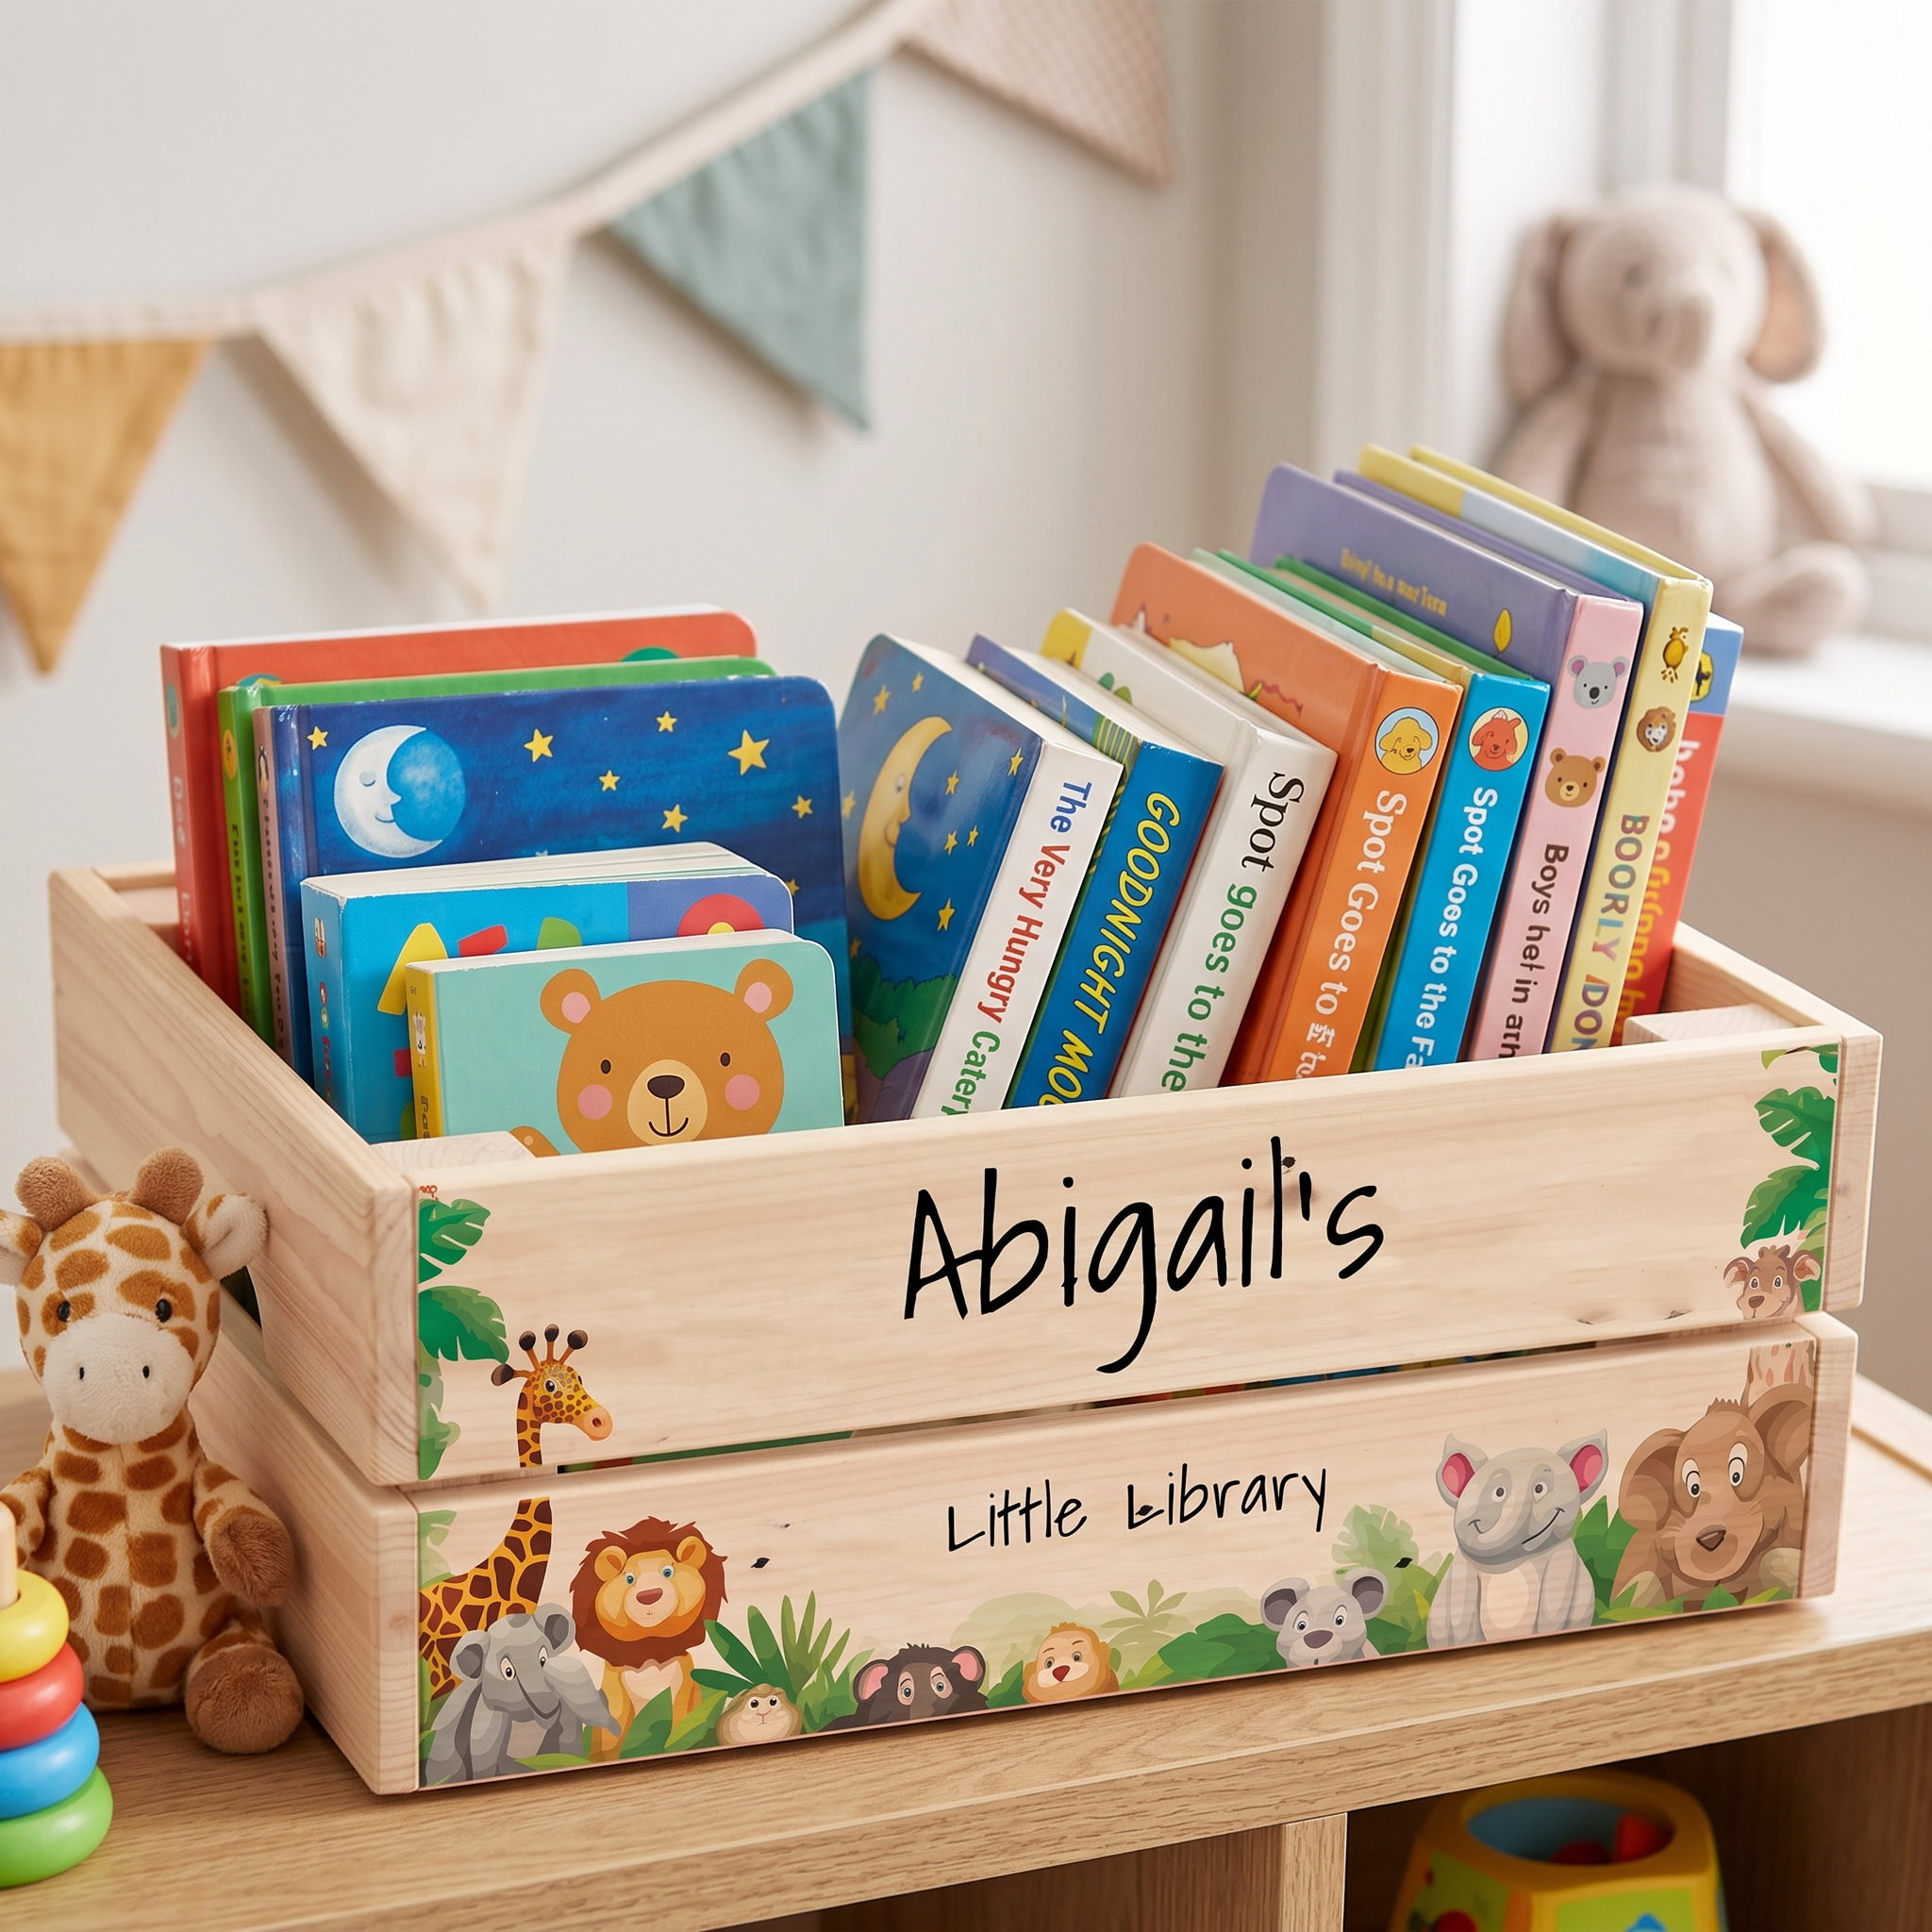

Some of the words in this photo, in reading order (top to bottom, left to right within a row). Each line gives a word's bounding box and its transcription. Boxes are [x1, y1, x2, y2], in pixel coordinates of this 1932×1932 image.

[1049, 782, 1093, 834] The
[1241, 771, 1306, 873] Spot
[1356, 790, 1407, 874] Spot
[1458, 787, 1499, 856] Spot
[1018, 844, 1072, 909] Very
[1074, 791, 1181, 1035] GOODNIGHT
[1438, 863, 1479, 938] Goes
[1531, 842, 1570, 915] Boys
[1204, 883, 1258, 974] goes
[1327, 881, 1379, 972] Goes
[1429, 945, 1457, 974] to
[976, 914, 1044, 1024] Hungry
[1187, 984, 1226, 1021] to
[1314, 980, 1349, 1016] to
[1415, 982, 1447, 1029] the
[1511, 978, 1539, 1004] in
[1160, 1031, 1210, 1092] the
[903, 1135, 1385, 1374] Abigail's
[947, 1478, 1088, 1553] Little
[1126, 1463, 1326, 1533] Library
